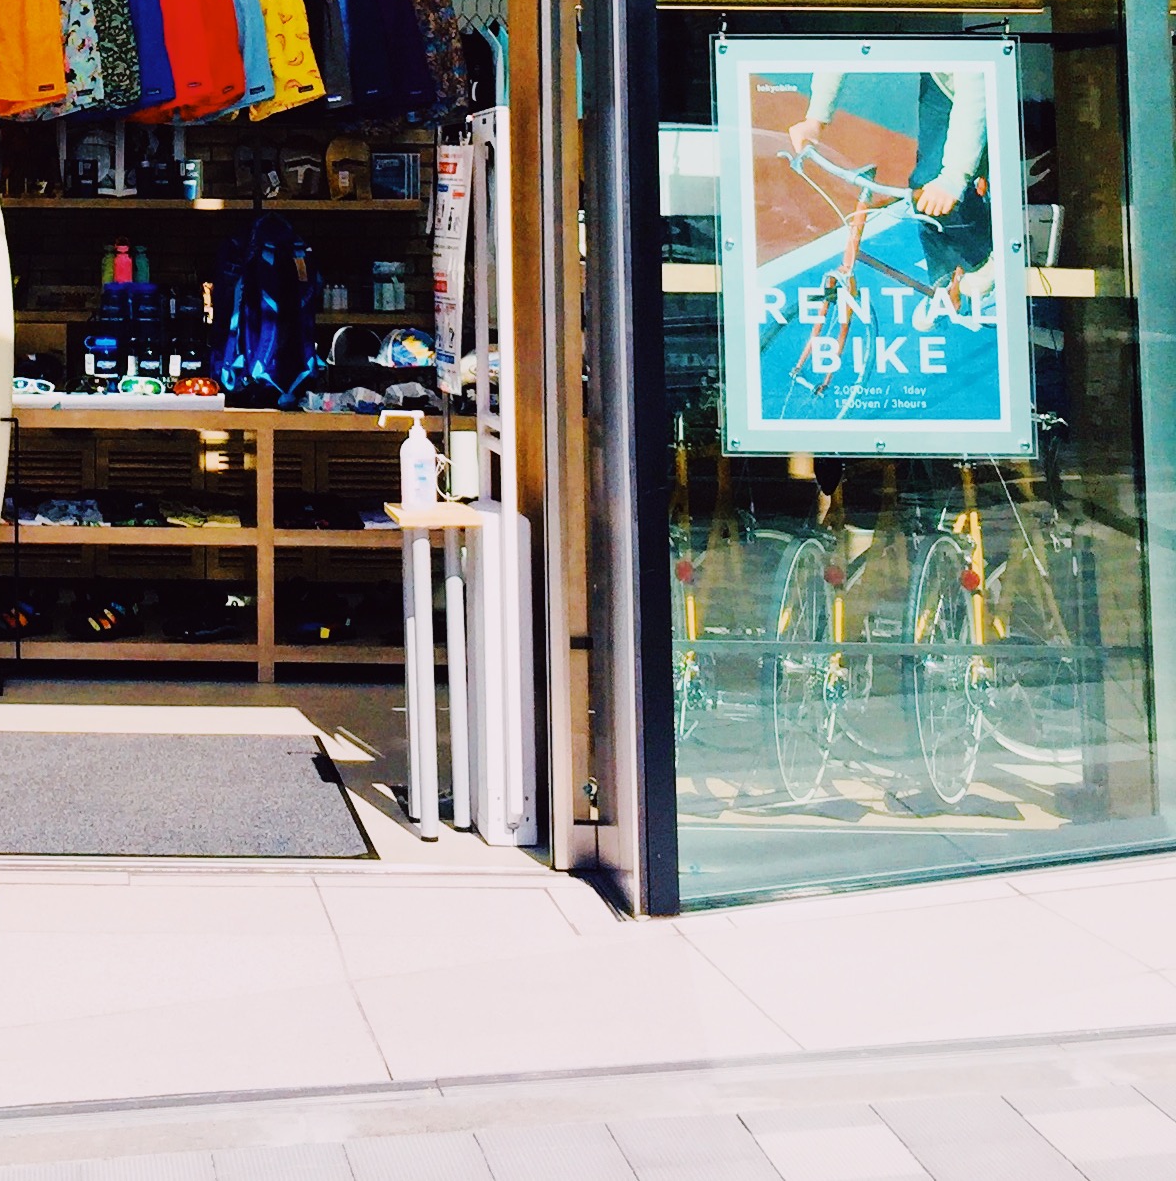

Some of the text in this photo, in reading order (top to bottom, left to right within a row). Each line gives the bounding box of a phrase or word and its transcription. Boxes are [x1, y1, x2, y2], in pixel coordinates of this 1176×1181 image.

[757, 286, 998, 325] RENTAL
[810, 336, 948, 374] BIKE
[903, 385, 927, 396] 1day
[891, 398, 928, 408] 3hours
